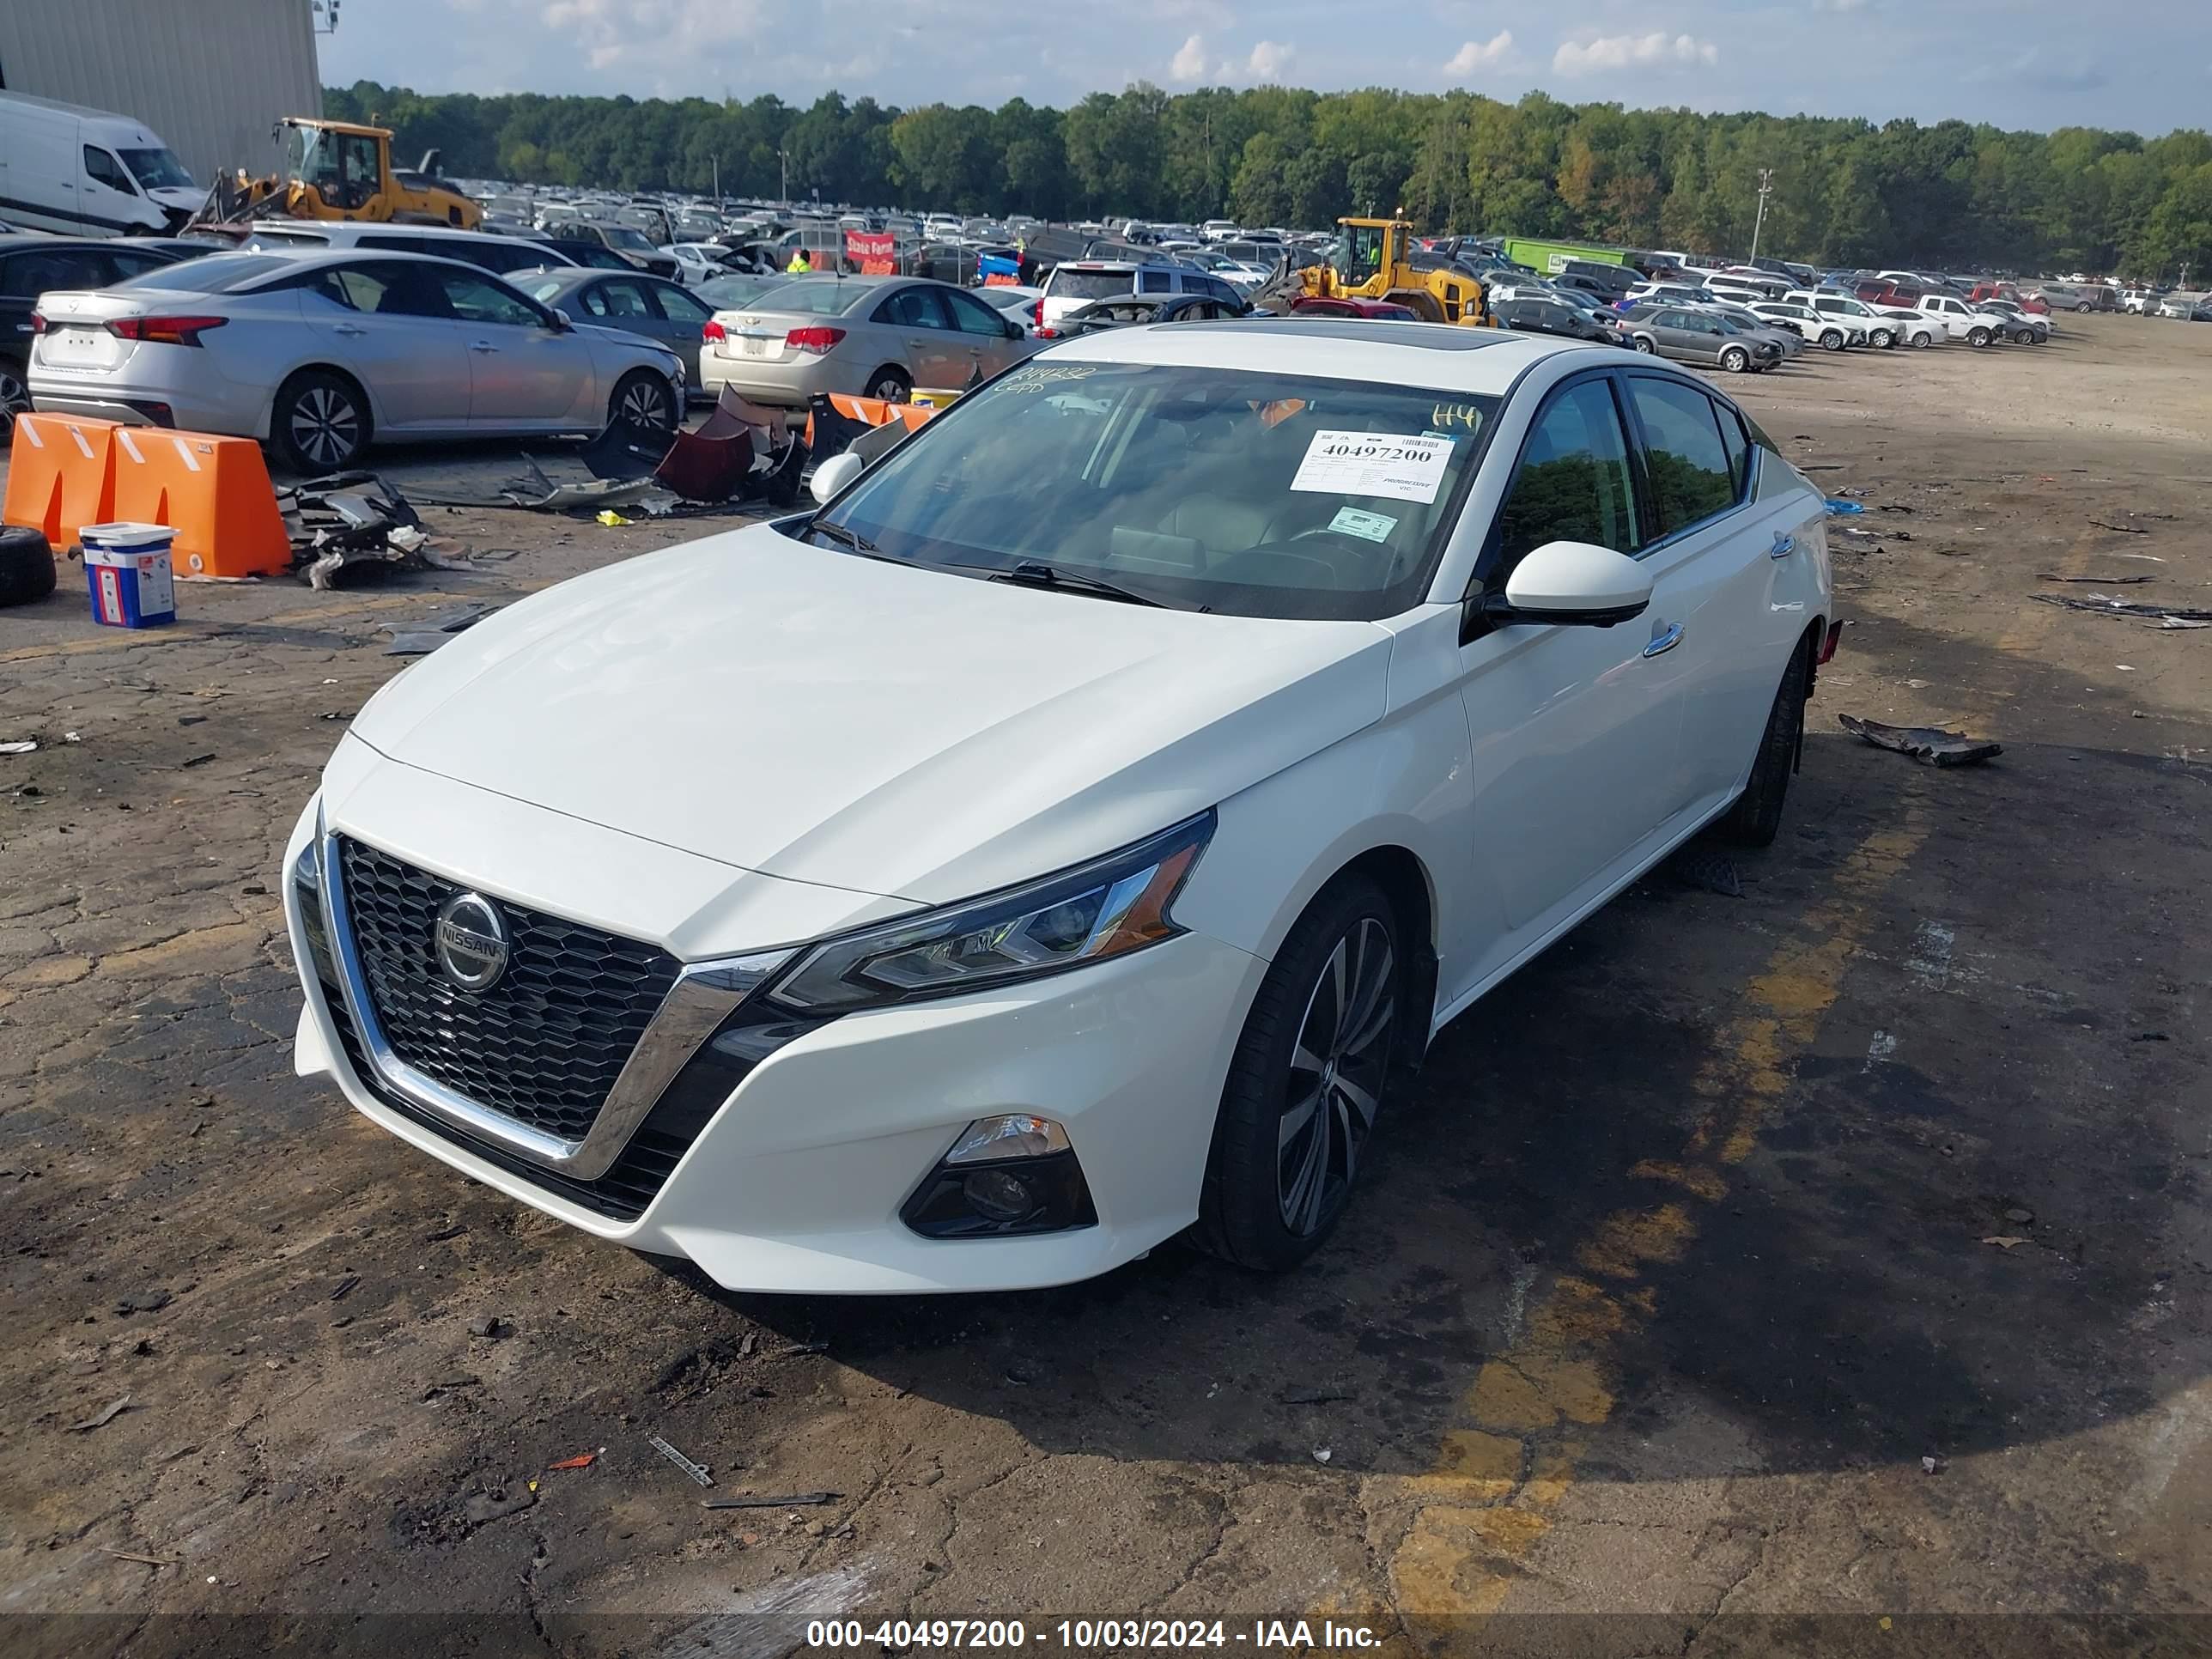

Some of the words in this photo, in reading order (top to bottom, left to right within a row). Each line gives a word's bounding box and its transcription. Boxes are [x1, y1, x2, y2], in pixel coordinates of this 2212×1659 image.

[848, 237, 870, 255] State
[871, 241, 892, 255] Farm
[1432, 404, 1476, 428] H4
[1322, 444, 1431, 463] 40497200
[442, 927, 496, 957] NISSAN
